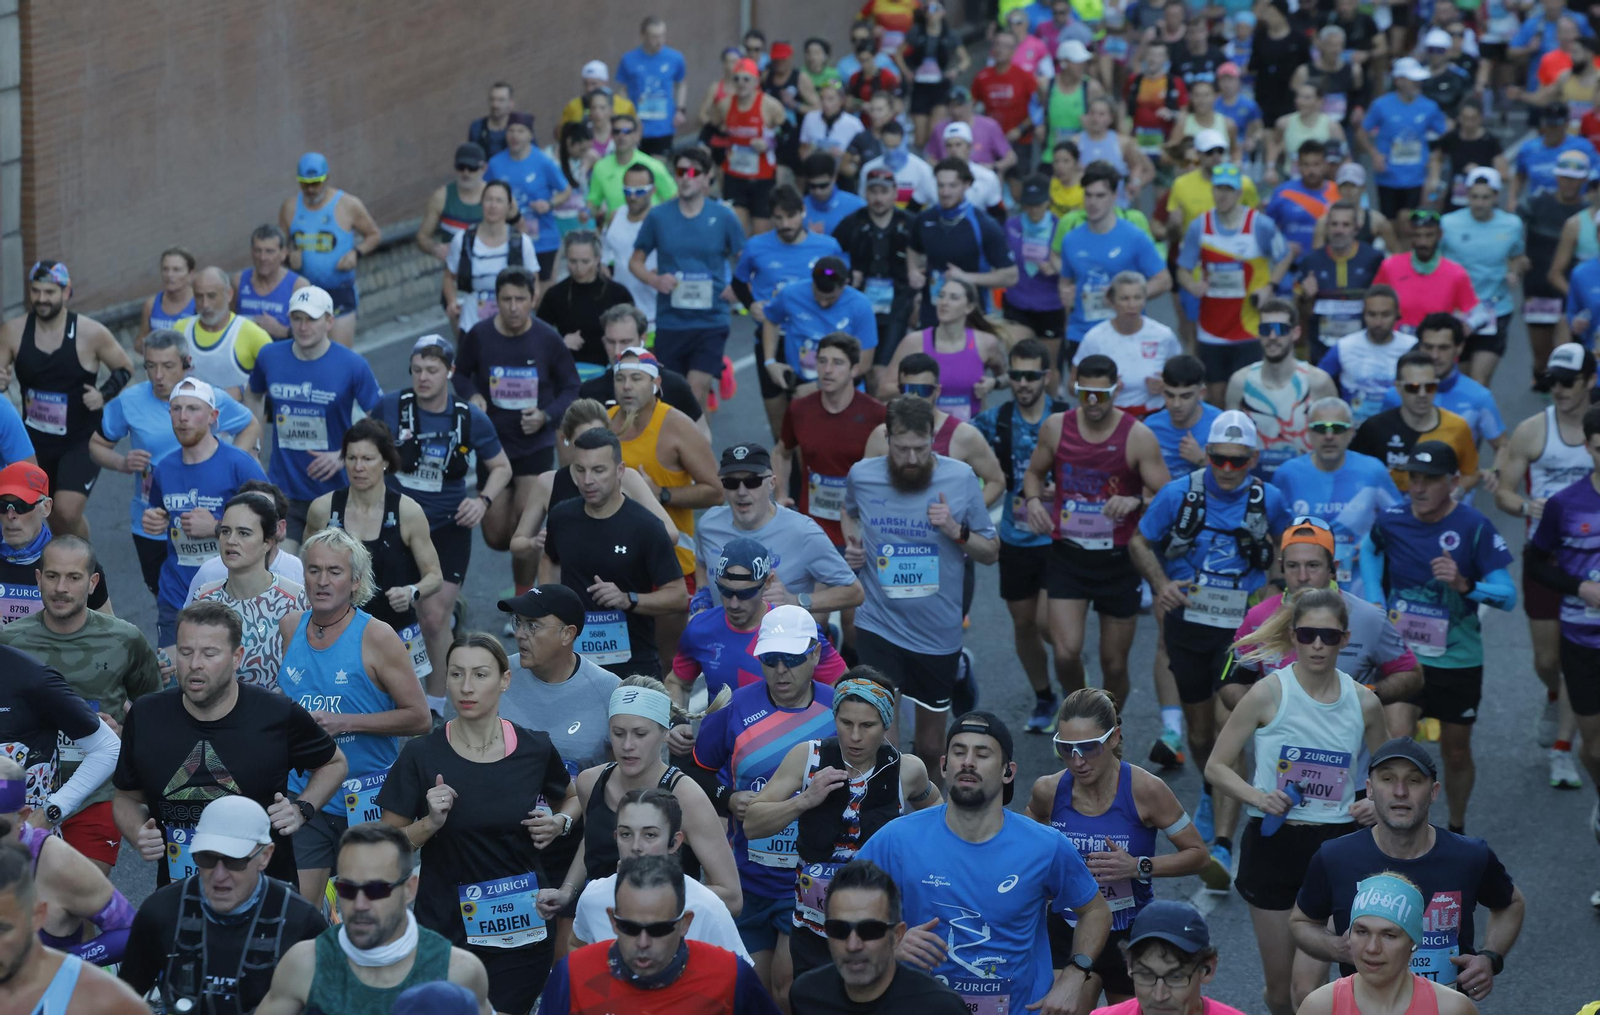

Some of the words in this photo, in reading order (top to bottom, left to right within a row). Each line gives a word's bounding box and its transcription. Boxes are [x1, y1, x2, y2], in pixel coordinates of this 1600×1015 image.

[293, 407, 319, 415] ZURICH
[286, 429, 317, 439] JAMES
[871, 518, 907, 526] MARSH
[881, 527, 927, 537] HARRIERS
[181, 541, 217, 553] FOSTER
[897, 546, 931, 554] ZURICH
[893, 573, 923, 584] ANDY
[10, 605, 29, 614] 8798
[1409, 604, 1443, 616] ZURICH
[587, 613, 619, 622] ZURICH
[582, 640, 617, 651] EDGAR
[1304, 752, 1343, 764] ZURICH
[1301, 769, 1321, 779] 9771
[767, 839, 797, 852] JOTA
[486, 878, 529, 895] ZURICH
[490, 903, 514, 914] 7459
[479, 914, 530, 933] FABIEN
[1422, 935, 1449, 945] RICH
[1408, 957, 1430, 967] 032
[954, 982, 1000, 992] ZURICH
